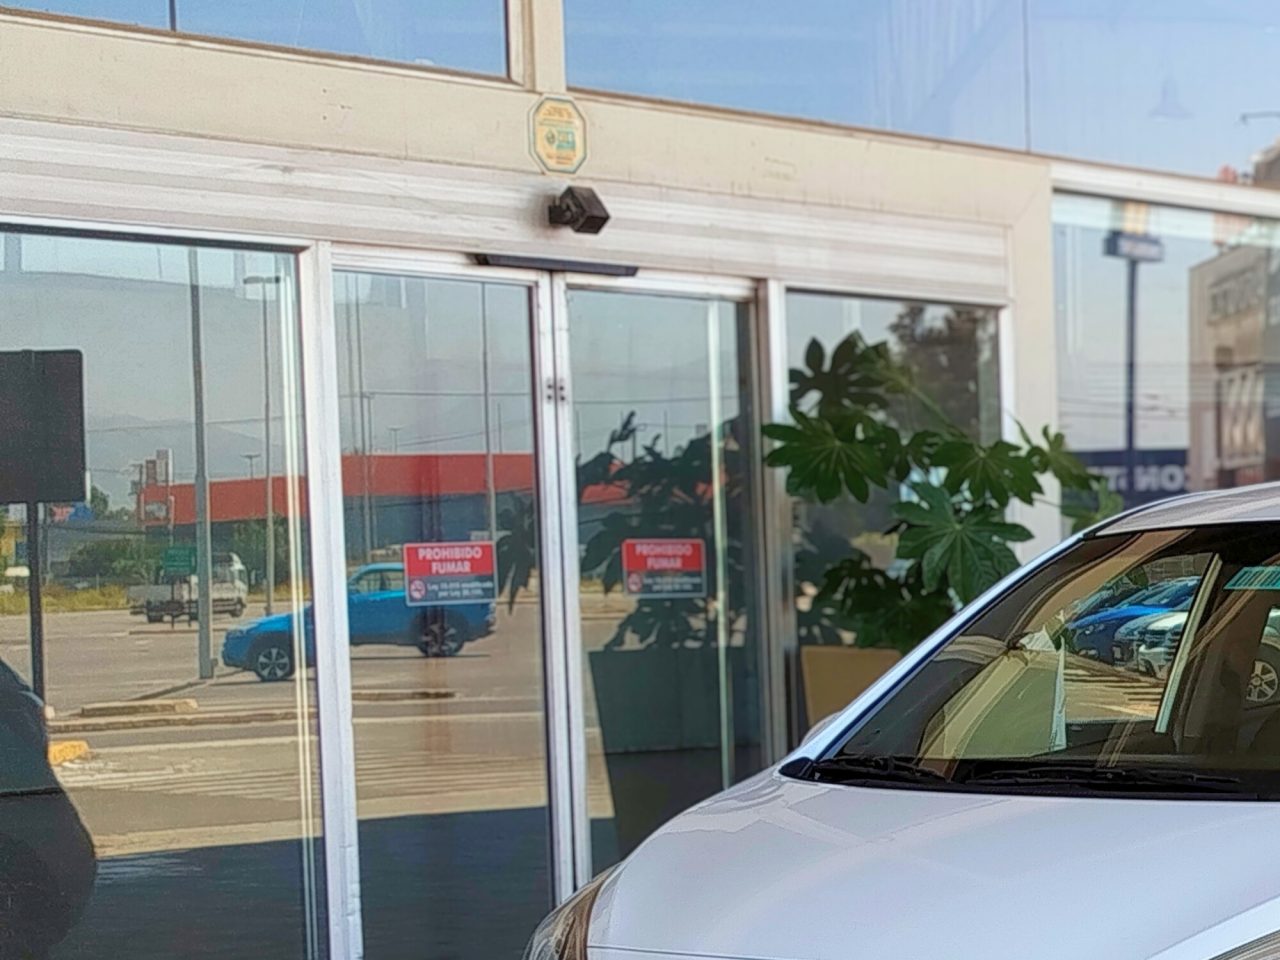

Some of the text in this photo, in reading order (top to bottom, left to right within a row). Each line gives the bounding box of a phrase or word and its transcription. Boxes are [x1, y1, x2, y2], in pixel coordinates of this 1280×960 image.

[418, 547, 482, 560] PROHIBIDO
[635, 544, 692, 556] PROHIBIDO
[431, 561, 471, 574] FUMAR
[647, 557, 682, 570] FUMAR
